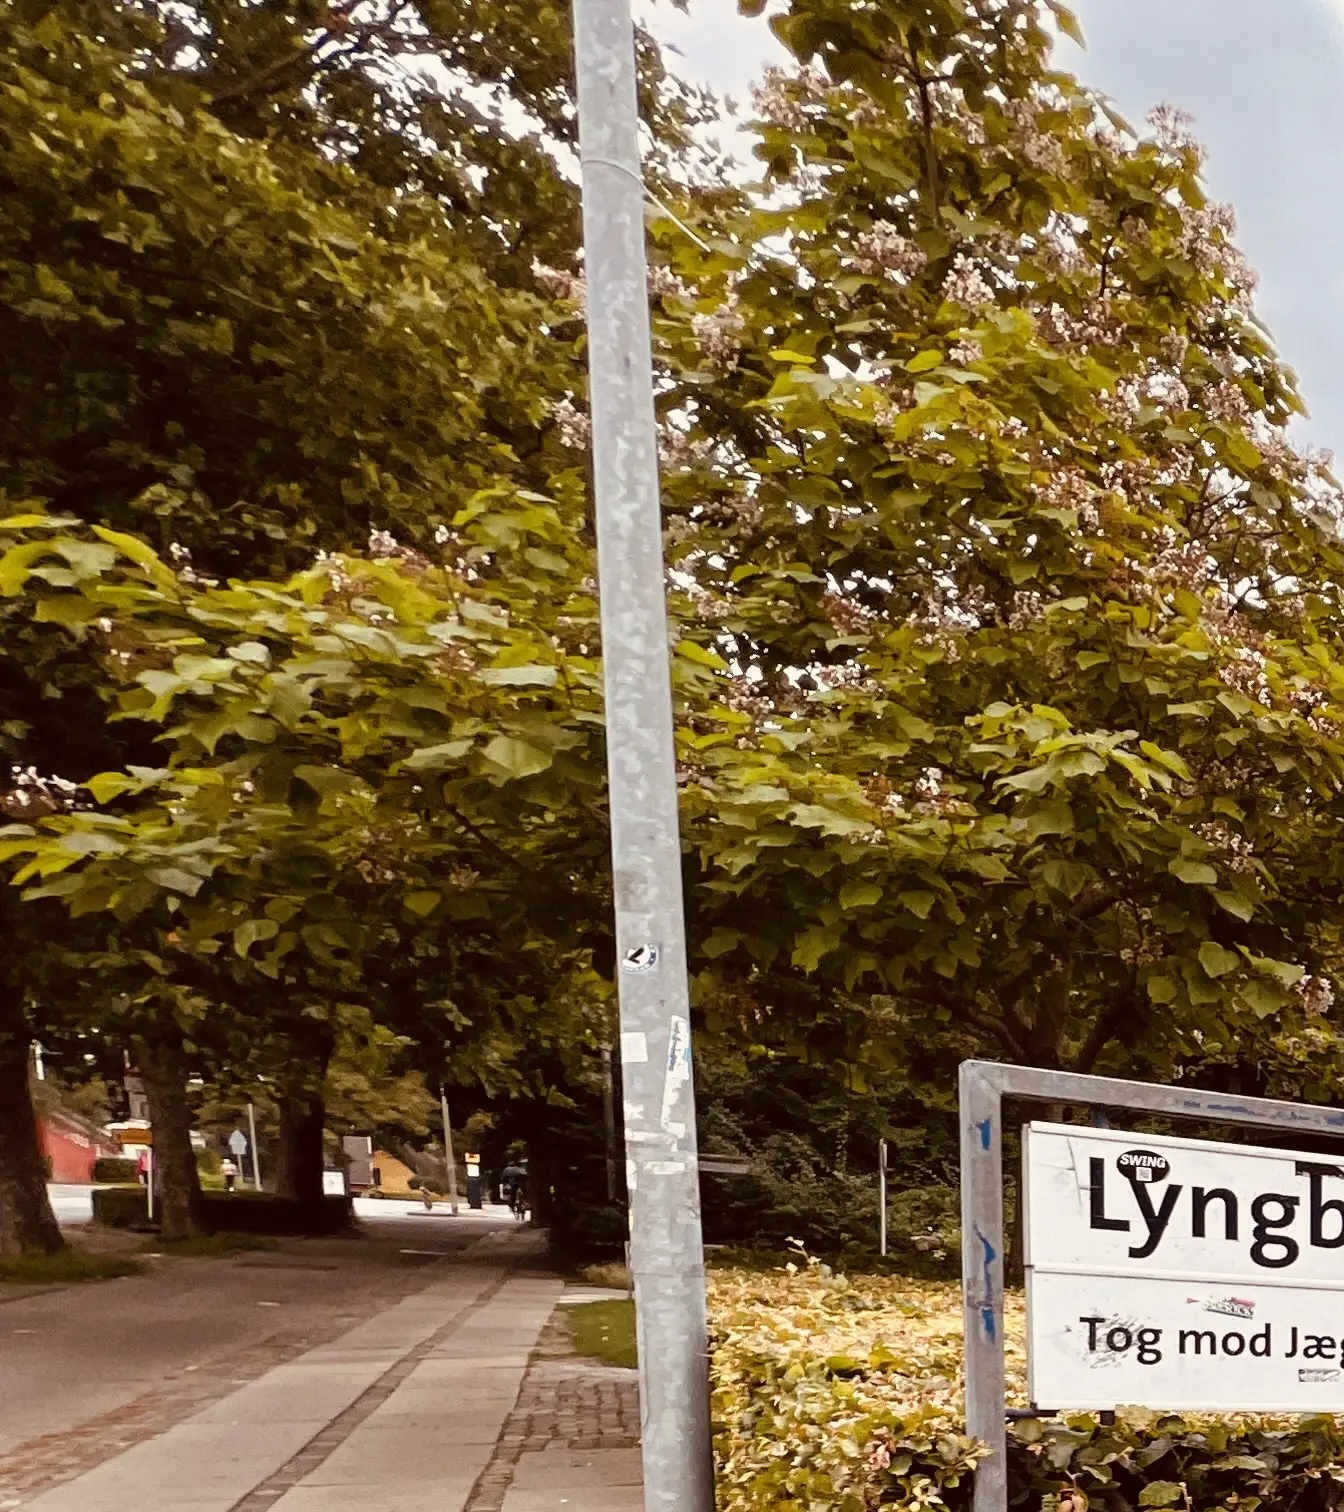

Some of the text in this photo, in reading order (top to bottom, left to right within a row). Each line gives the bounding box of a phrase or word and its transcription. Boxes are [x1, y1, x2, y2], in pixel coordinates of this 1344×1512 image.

[1120, 1154, 1166, 1168] SWING
[1080, 1316, 1163, 1366] Tog
[1178, 1323, 1271, 1357] mod
